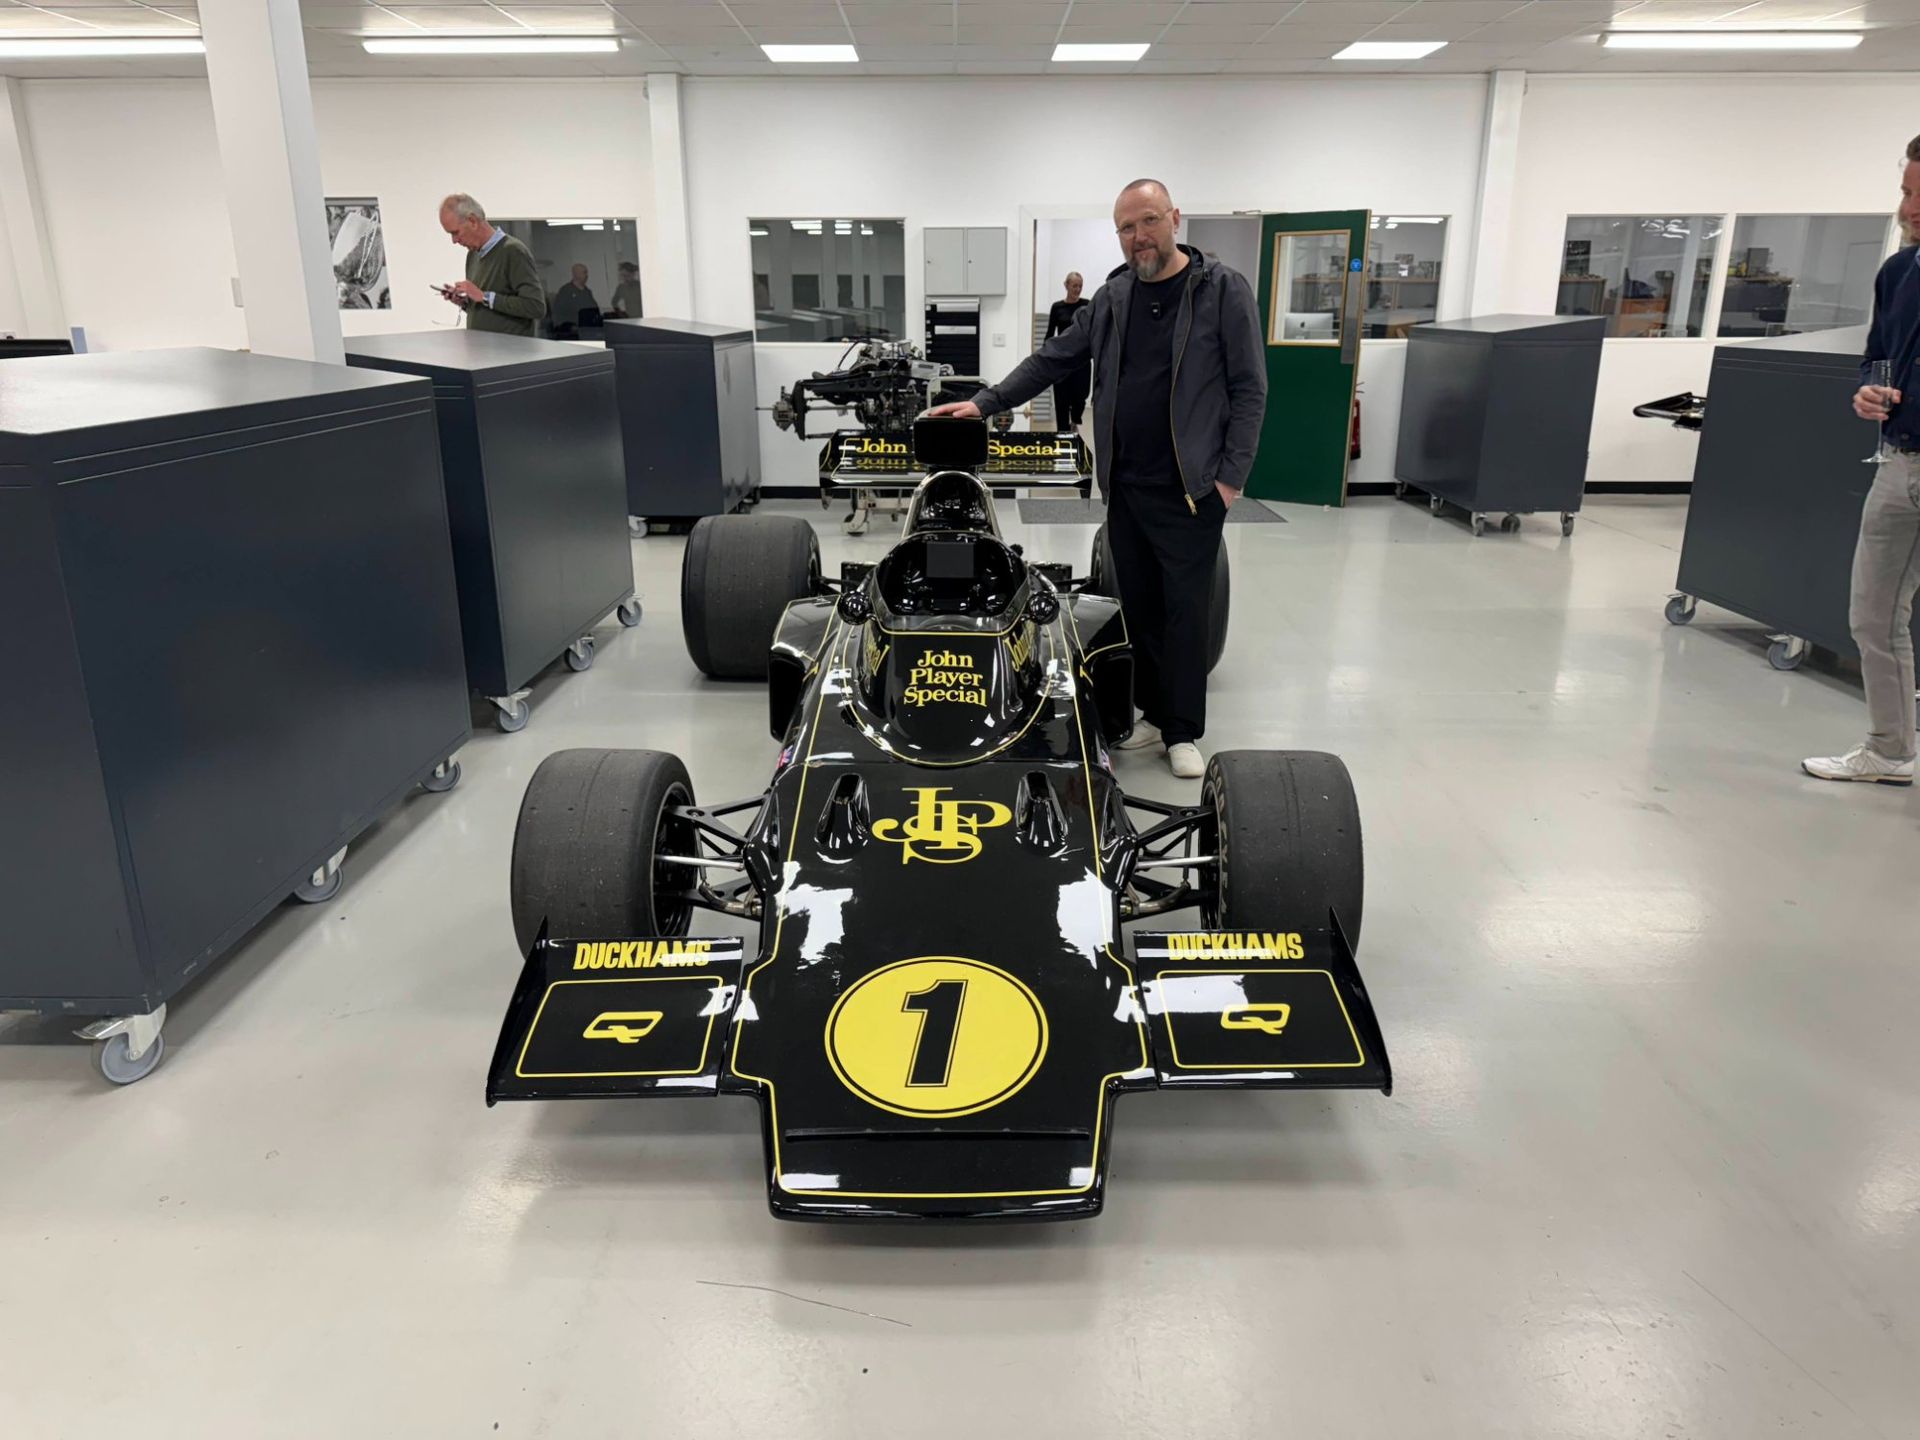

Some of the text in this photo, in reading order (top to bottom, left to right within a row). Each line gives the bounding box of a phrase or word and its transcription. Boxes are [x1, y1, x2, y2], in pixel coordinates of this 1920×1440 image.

[856, 438, 1061, 457] John Special
[917, 650, 974, 668] John
[909, 668, 983, 687] Player
[903, 685, 987, 707] Special
[573, 940, 712, 970] DUCKHAMS
[1167, 933, 1304, 960] DUCKHAMS
[900, 979, 969, 1088] 1
